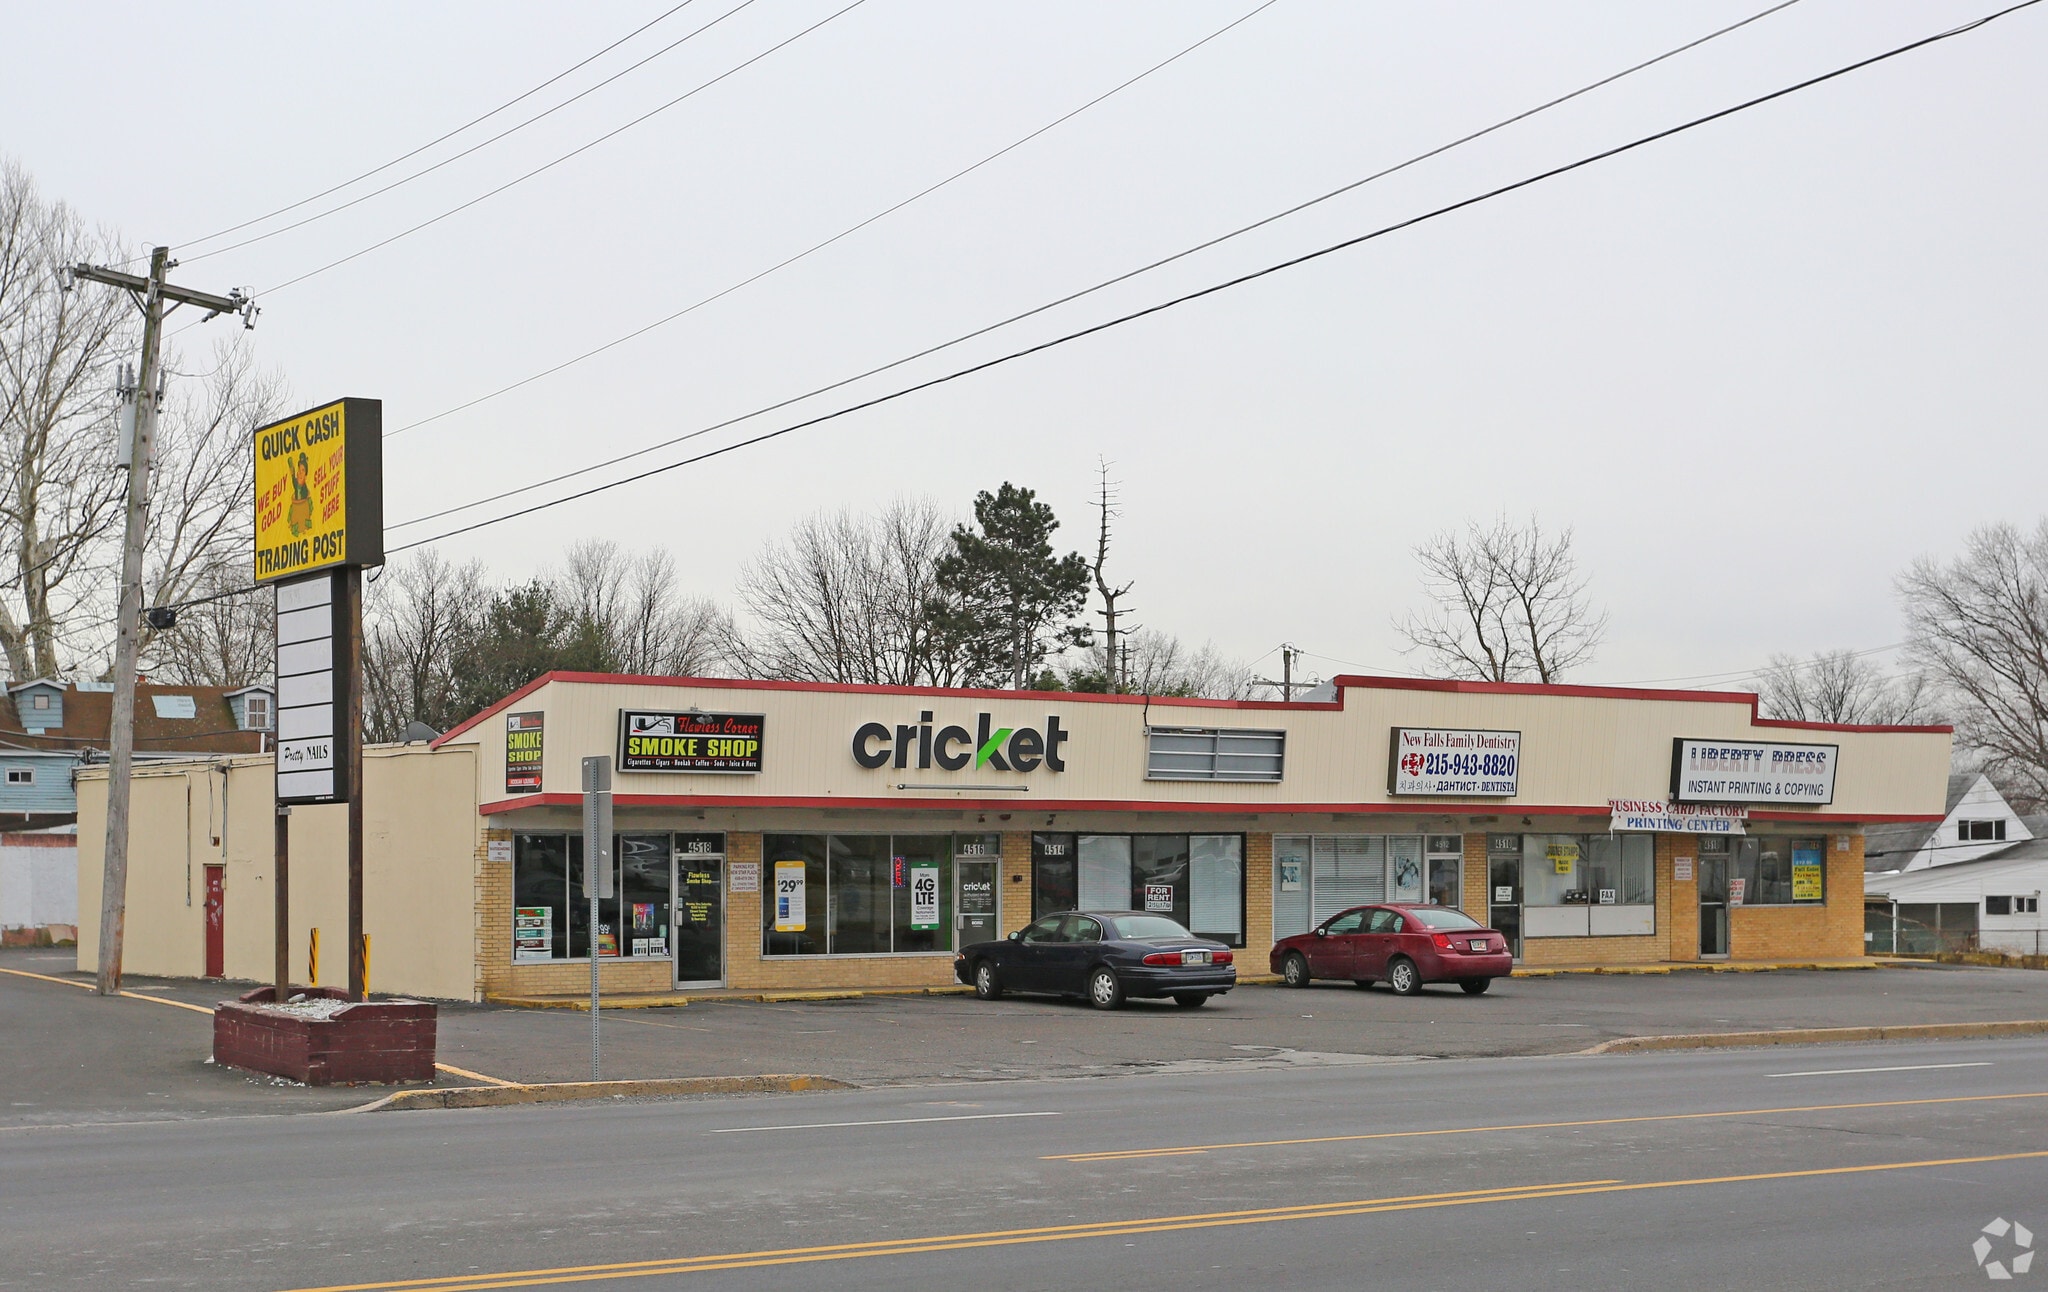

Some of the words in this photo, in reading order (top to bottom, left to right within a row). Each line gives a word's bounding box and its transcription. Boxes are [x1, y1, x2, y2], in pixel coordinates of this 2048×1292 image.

[262, 425, 301, 461] QUICK
[305, 411, 339, 447] CASH
[313, 464, 327, 489] SELL
[329, 444, 344, 472] YOUR
[257, 490, 270, 515] WE
[272, 473, 288, 503] BUY
[319, 470, 341, 504] STUFF
[261, 501, 282, 532] GOLD
[322, 493, 340, 525] HERE
[258, 539, 309, 574] TRADING
[313, 529, 344, 562] POST
[723, 718, 759, 734] Corner
[508, 731, 542, 750] SMOKE
[628, 737, 698, 756] SMOKE
[707, 739, 758, 757] SHOP
[852, 710, 1068, 772] cricket
[1402, 731, 1421, 747] New
[1423, 732, 1444, 748] Falls
[1446, 733, 1475, 750] Family
[1476, 734, 1517, 751] Dentistry
[284, 747, 303, 764] Pretty
[306, 745, 328, 760] NAILS
[508, 751, 541, 762] SHOP
[1690, 747, 1764, 772] LIBERTY
[1771, 750, 1827, 775] PRESS
[1425, 753, 1515, 777] 215-943-8820
[1399, 780, 1432, 793] 치과의사
[1481, 781, 1515, 792] DENTISTA
[1688, 780, 1726, 794] INSTANT
[1728, 781, 1772, 795] PRINTING
[1774, 783, 1781, 795] &
[1784, 782, 1824, 796] COPYING
[1666, 803, 1696, 816] CARD
[1699, 804, 1746, 817] FACTORY
[1627, 817, 1682, 831] PRINTING
[1687, 819, 1730, 832] CENTER
[688, 842, 711, 853] 4518
[964, 844, 984, 854] 4516
[1044, 844, 1064, 855] 4514
[915, 878, 935, 891] 4G
[963, 882, 991, 891] cricket
[916, 892, 934, 905] LTE
[1601, 890, 1613, 898] FAX
